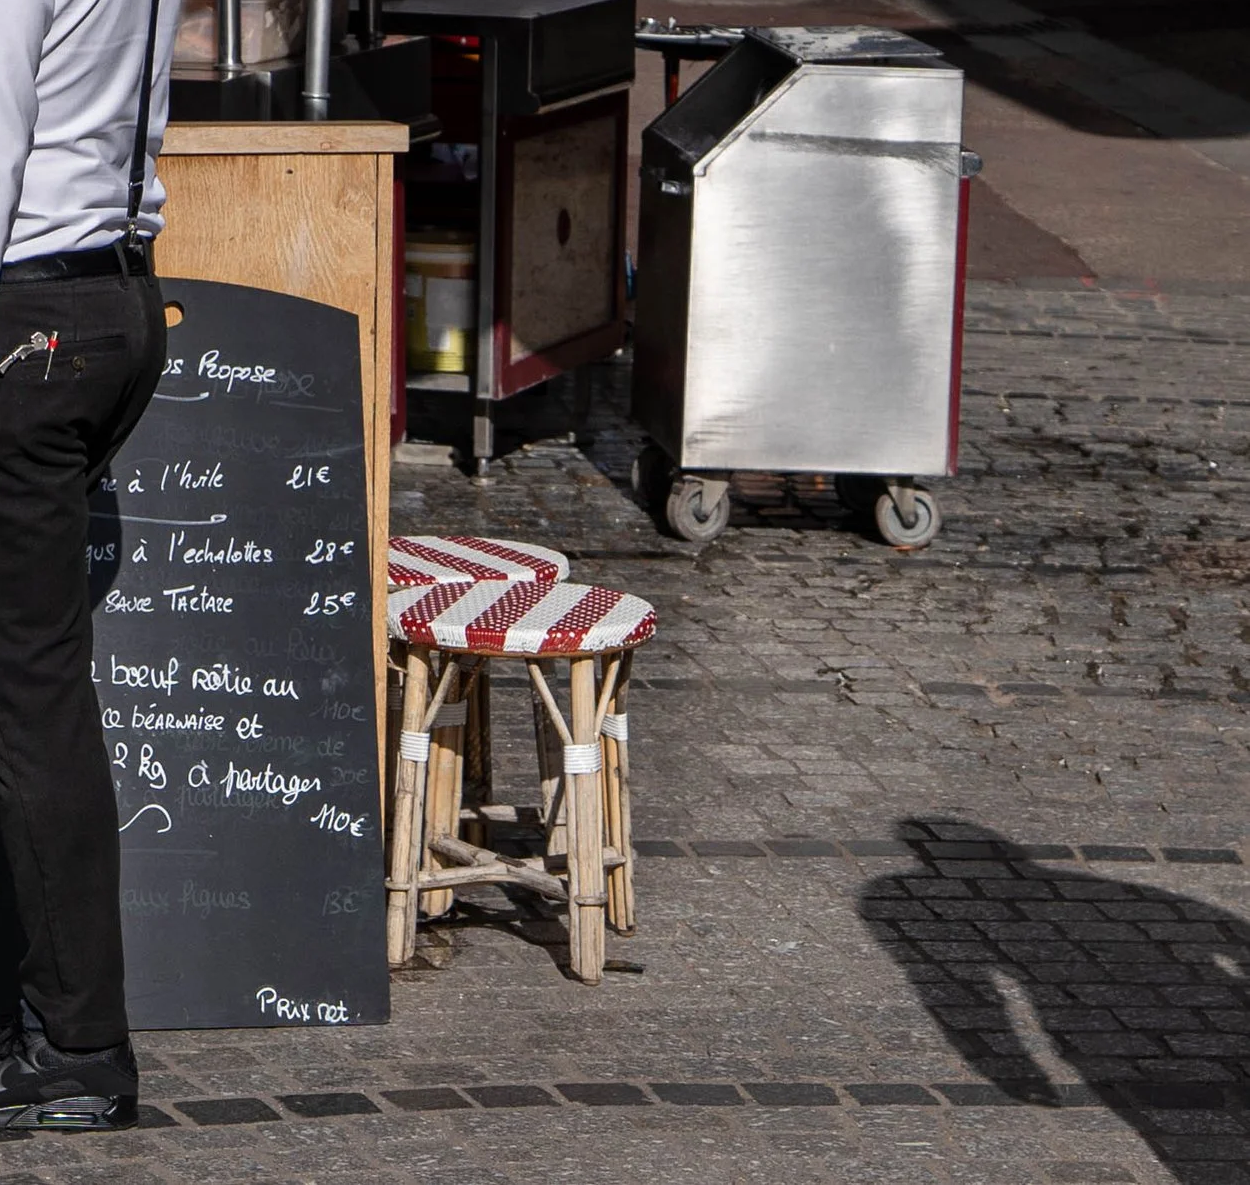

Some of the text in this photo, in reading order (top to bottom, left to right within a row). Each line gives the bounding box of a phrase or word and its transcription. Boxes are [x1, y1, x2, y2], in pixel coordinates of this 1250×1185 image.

[127, 469, 145, 494] à
[286, 464, 331, 490] 21€
[131, 538, 148, 563] à
[305, 538, 355, 565] 28€
[303, 591, 356, 616] 25€
[262, 677, 300, 700] au
[235, 713, 264, 740] et
[187, 759, 211, 788] à
[310, 803, 365, 837] 110€
